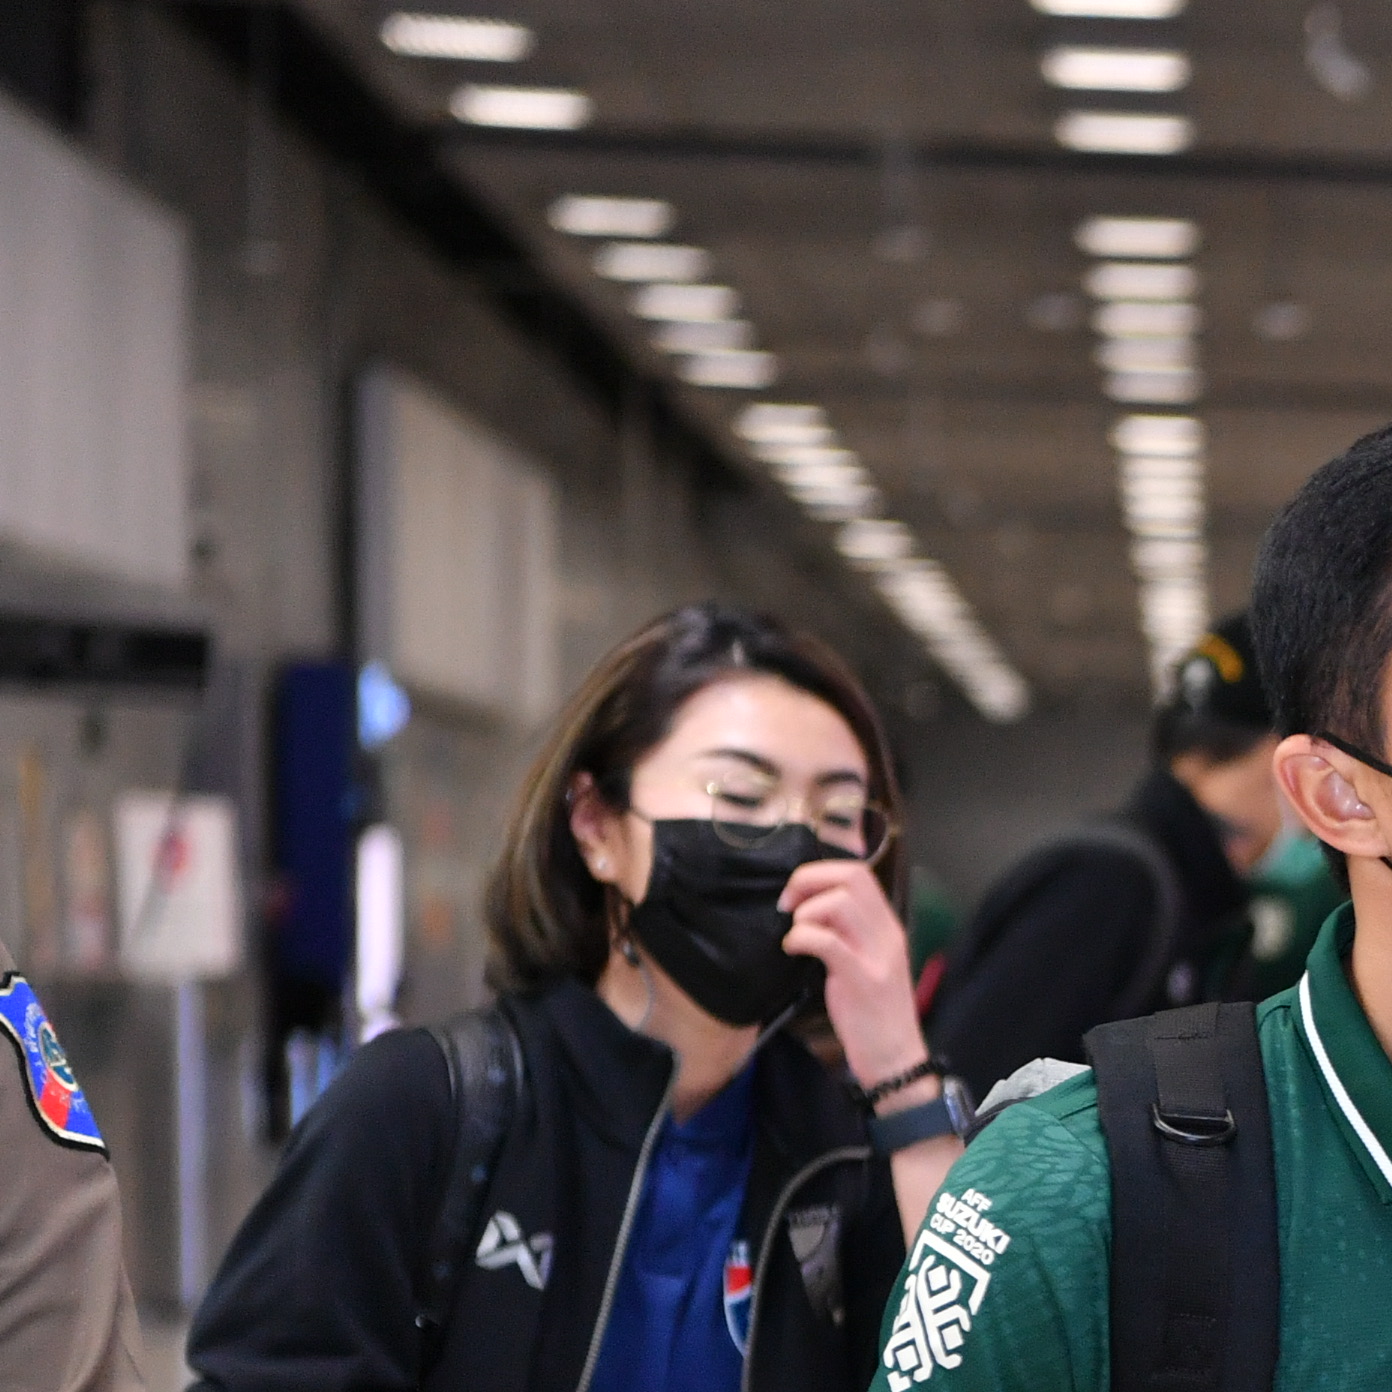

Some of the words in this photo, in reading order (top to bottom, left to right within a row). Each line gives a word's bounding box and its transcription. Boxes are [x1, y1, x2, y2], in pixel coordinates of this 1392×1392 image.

[937, 1193, 1010, 1253] SUZUKI
[961, 1188, 992, 1211] AFF
[930, 1213, 955, 1234] CUP
[954, 1229, 994, 1265] 2020
